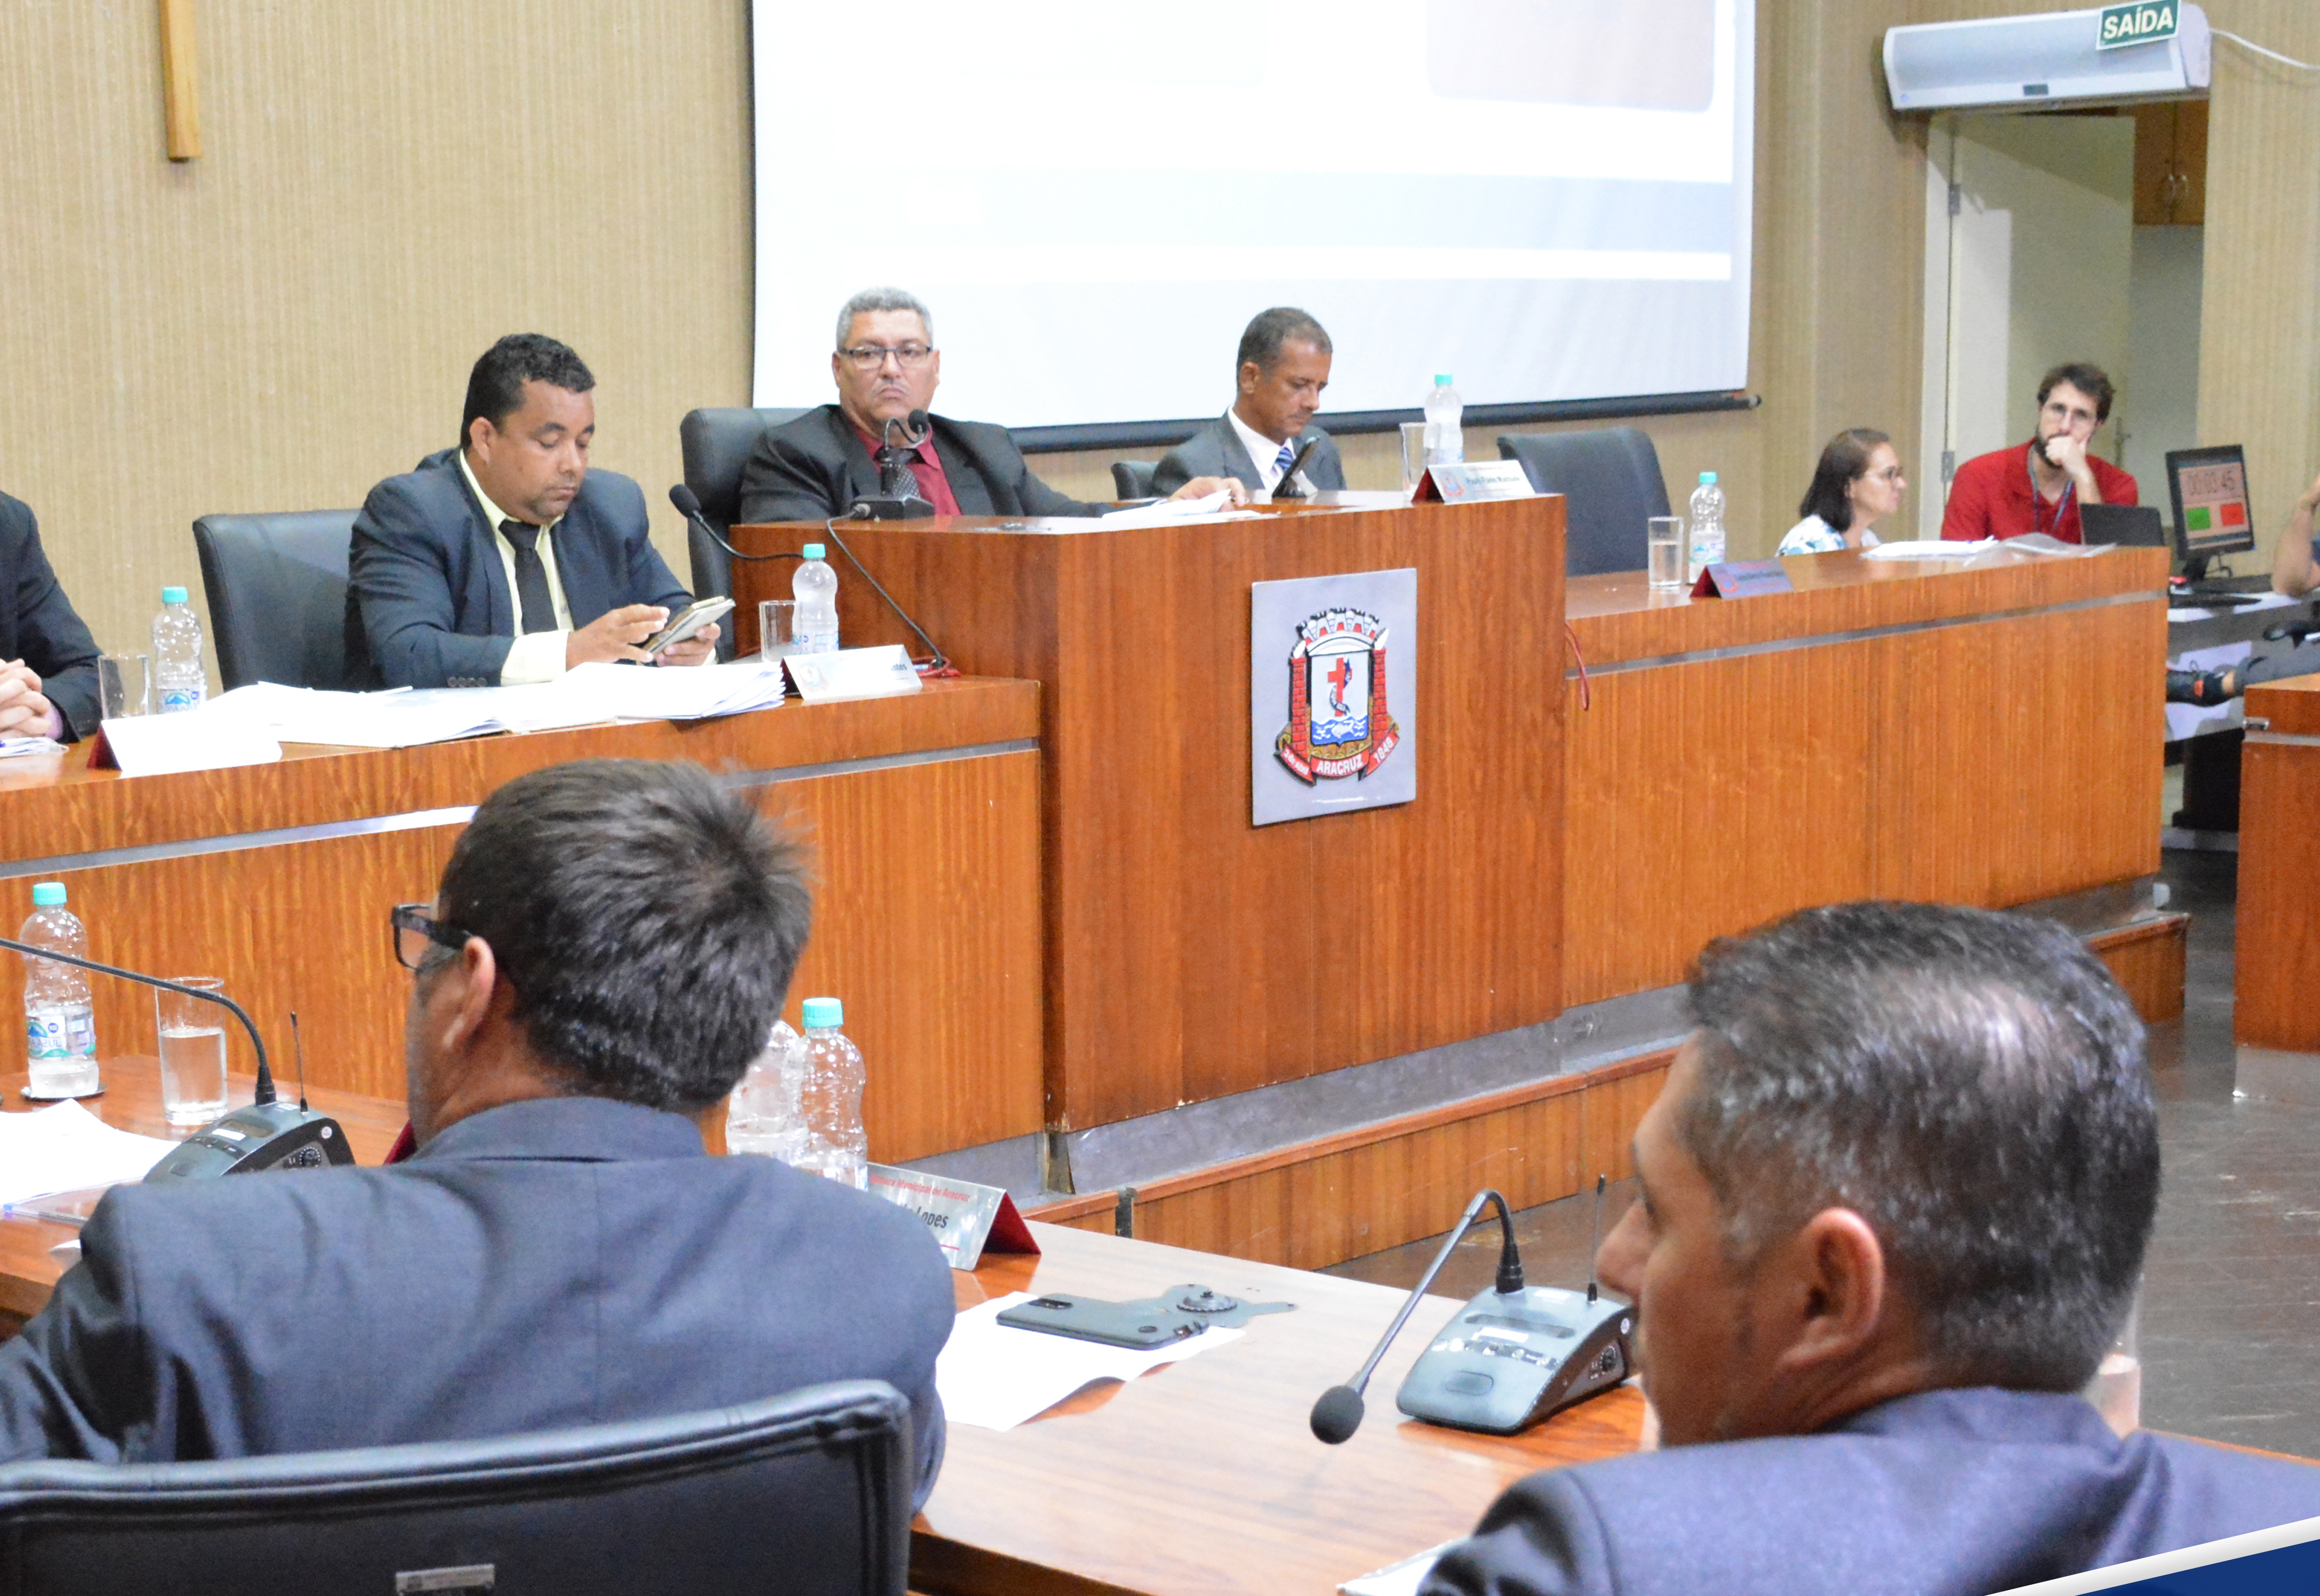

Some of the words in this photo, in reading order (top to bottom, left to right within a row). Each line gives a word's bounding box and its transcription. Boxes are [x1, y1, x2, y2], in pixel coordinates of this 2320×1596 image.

[2103, 5, 2174, 40] SAÍDA
[1374, 737, 1393, 763] 1848
[1316, 754, 1363, 775] ARACRUZ
